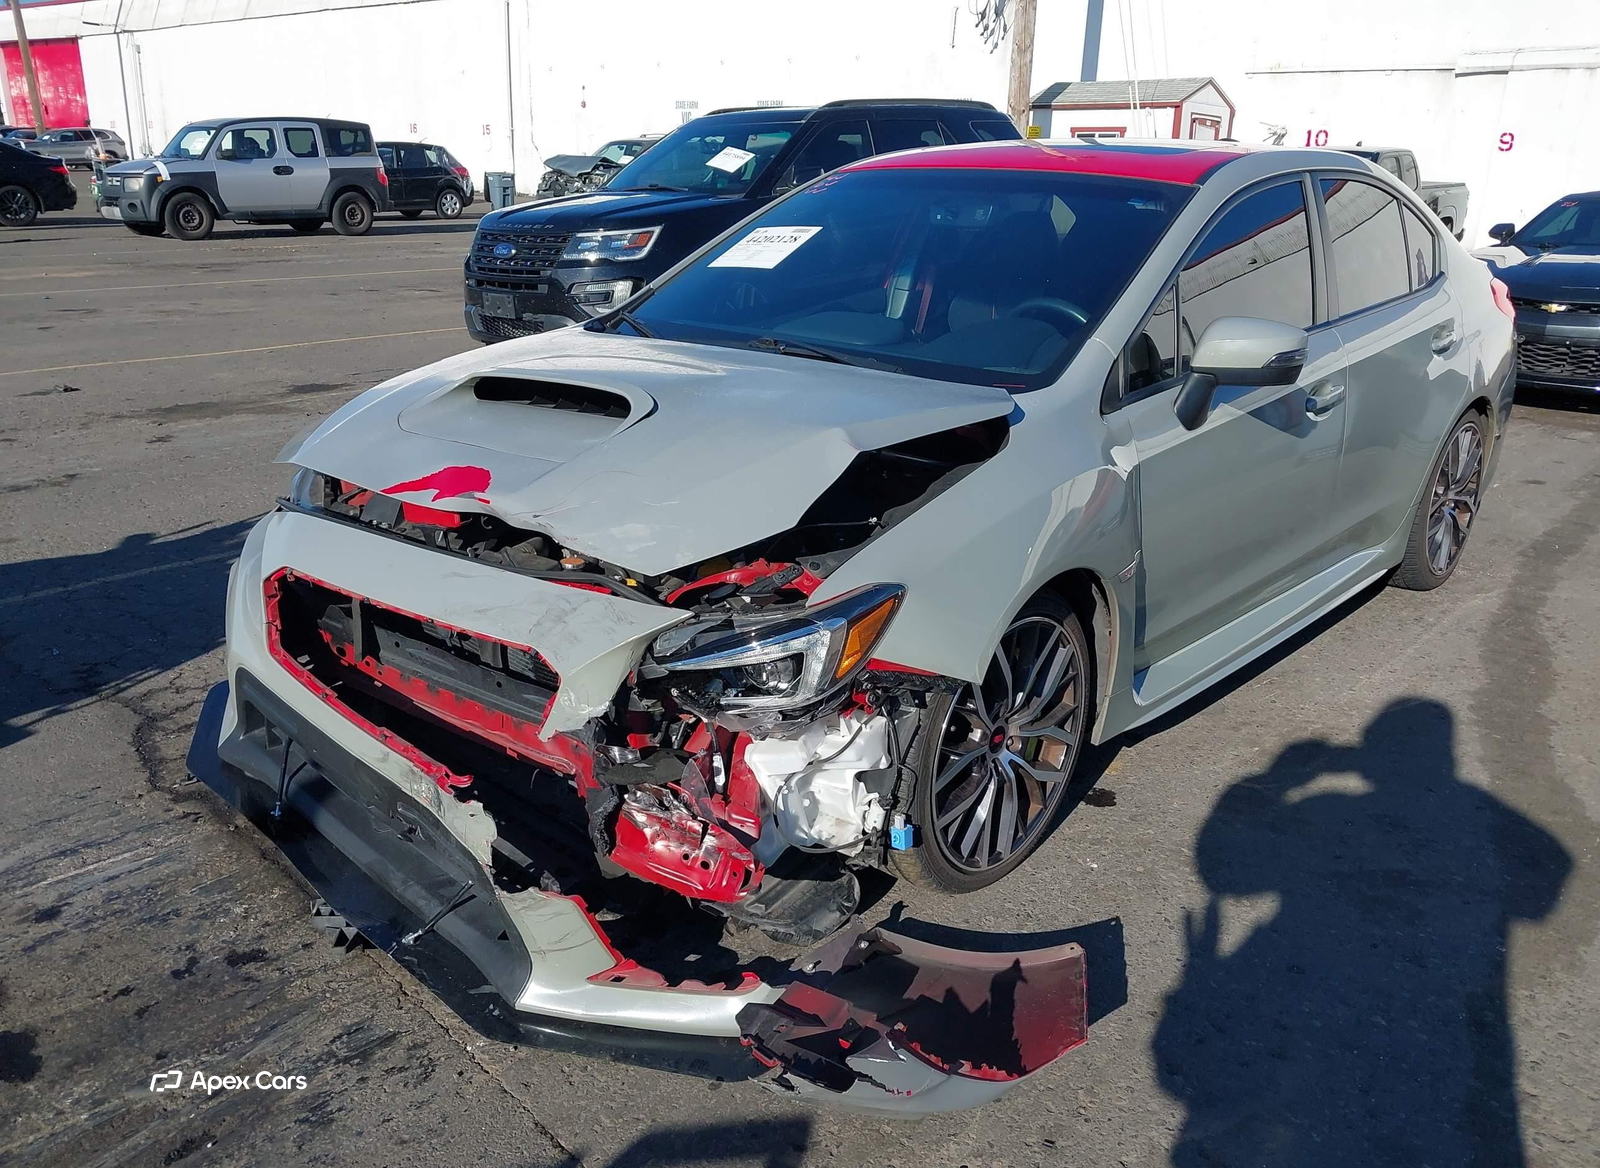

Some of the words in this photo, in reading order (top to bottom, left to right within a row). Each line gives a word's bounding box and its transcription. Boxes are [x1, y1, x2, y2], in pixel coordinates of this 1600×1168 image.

[675, 101, 687, 109] STATE
[410, 123, 418, 133] 16
[482, 124, 491, 135] 15
[1305, 130, 1329, 147] 10
[1498, 132, 1515, 151] 9
[746, 235, 802, 244] 44202128
